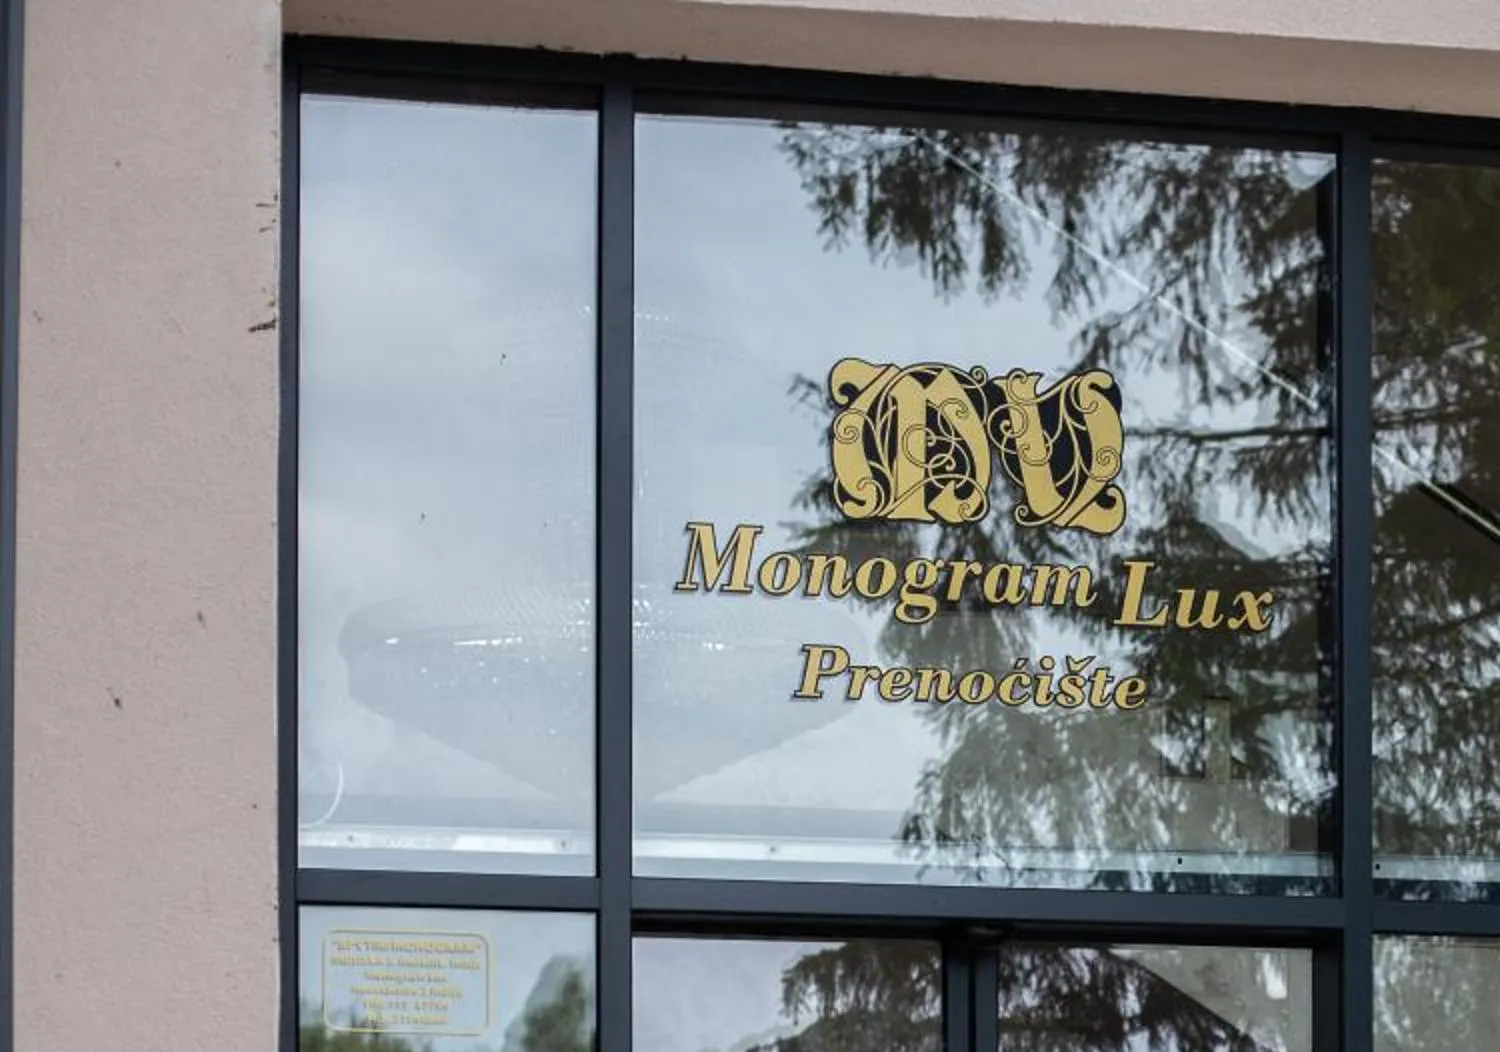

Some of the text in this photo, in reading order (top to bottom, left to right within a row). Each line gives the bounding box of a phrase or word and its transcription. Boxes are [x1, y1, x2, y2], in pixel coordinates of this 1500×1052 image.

[673, 520, 1274, 632] Monogram Lux
[794, 643, 1148, 710] Prenoćište
